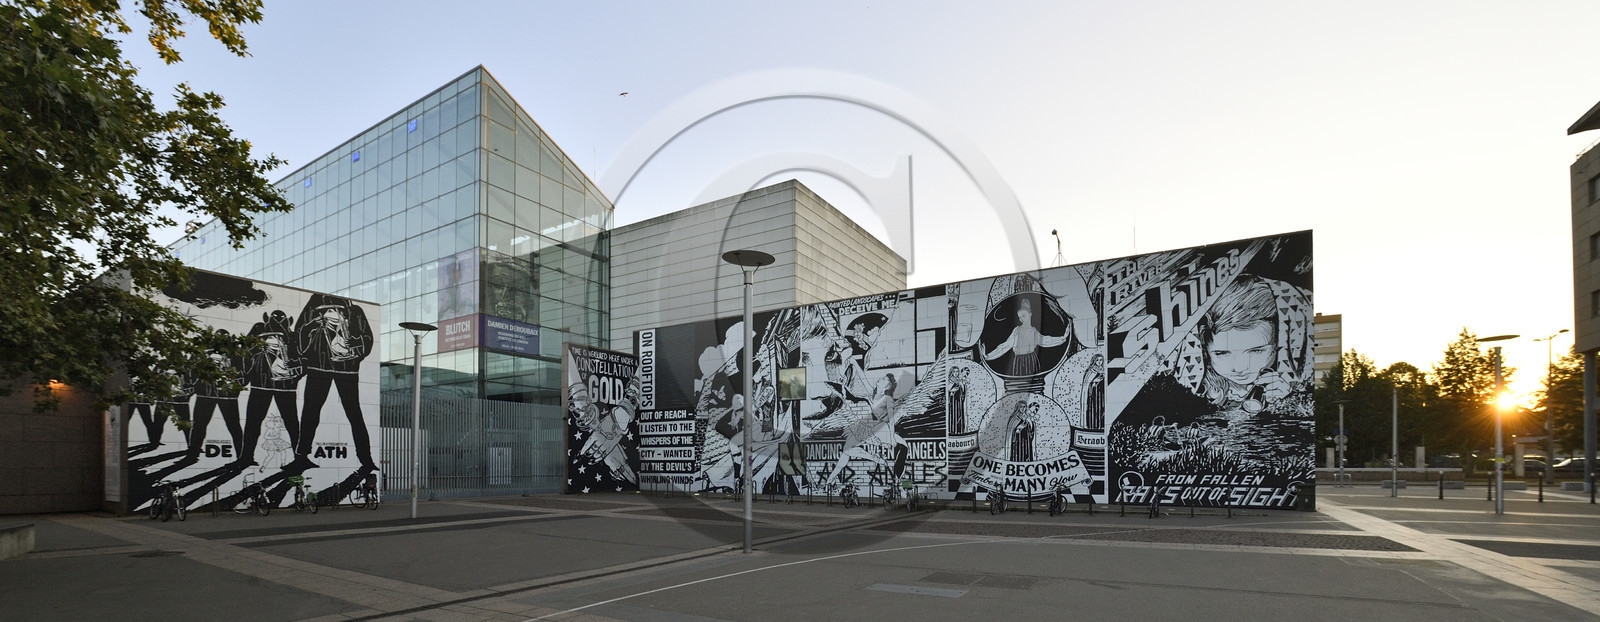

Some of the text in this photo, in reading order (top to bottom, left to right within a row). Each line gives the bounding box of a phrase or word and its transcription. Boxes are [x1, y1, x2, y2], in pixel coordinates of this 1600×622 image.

[838, 299, 896, 315] DECEIVE ME
[445, 320, 470, 335] BLUTCH
[487, 320, 508, 330] DAMIEN
[509, 324, 538, 337] DEROUBAIX
[575, 356, 634, 378] CONSTELLATION
[641, 331, 653, 408] ON ROOFTOPS
[588, 374, 624, 405] GOLD
[641, 412, 653, 420] OUT
[654, 411, 663, 420] OF
[664, 410, 687, 419] REACH
[645, 424, 668, 433] LISTEN
[669, 423, 678, 432] TO
[680, 422, 693, 431] THE
[640, 436, 693, 446] WHISPERS OF THE
[205, 444, 233, 458] DE
[314, 446, 347, 459] ATH
[641, 450, 655, 458] CITY
[663, 449, 692, 458] WANTED
[907, 442, 946, 460] ANGELS
[641, 462, 692, 471] BY THE DEVIL'S
[972, 455, 1080, 477] ONE BECOMES
[640, 476, 694, 485] WHIRLING WINDS
[1004, 477, 1048, 492] MANY
[1155, 474, 1266, 486] FROM FALLEN
